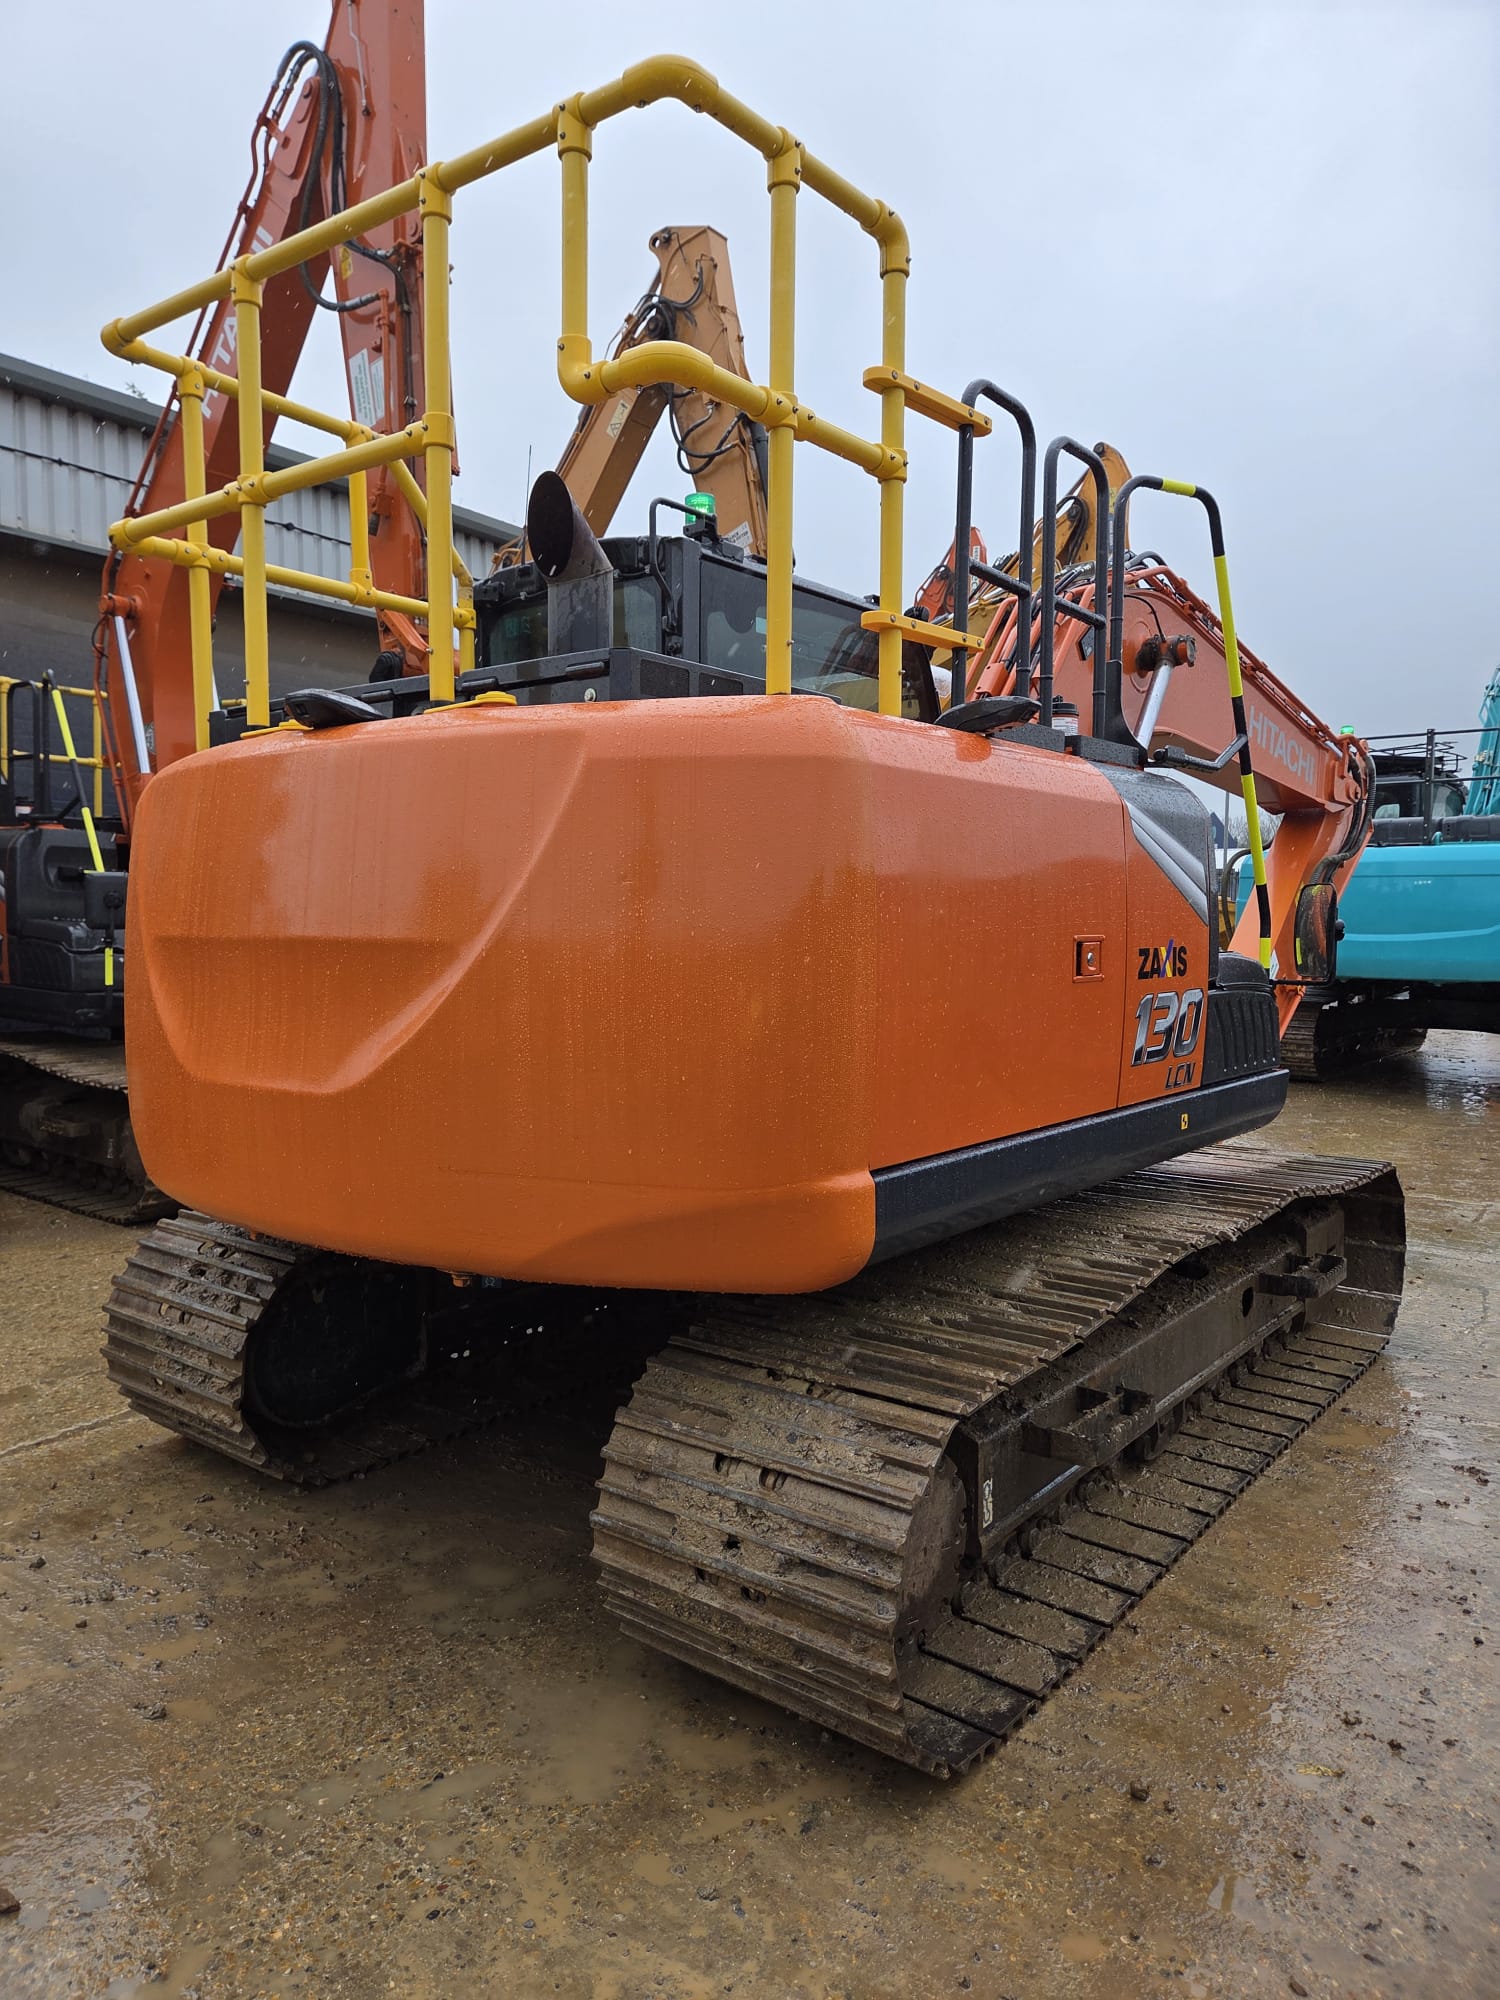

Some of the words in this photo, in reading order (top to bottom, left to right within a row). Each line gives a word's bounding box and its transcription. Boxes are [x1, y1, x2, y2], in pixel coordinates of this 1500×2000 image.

[1249, 705, 1316, 785] HITACHI
[1137, 938, 1188, 980] ZAXIS
[1131, 988, 1204, 1067] 130
[1164, 1061, 1196, 1090] LCN
